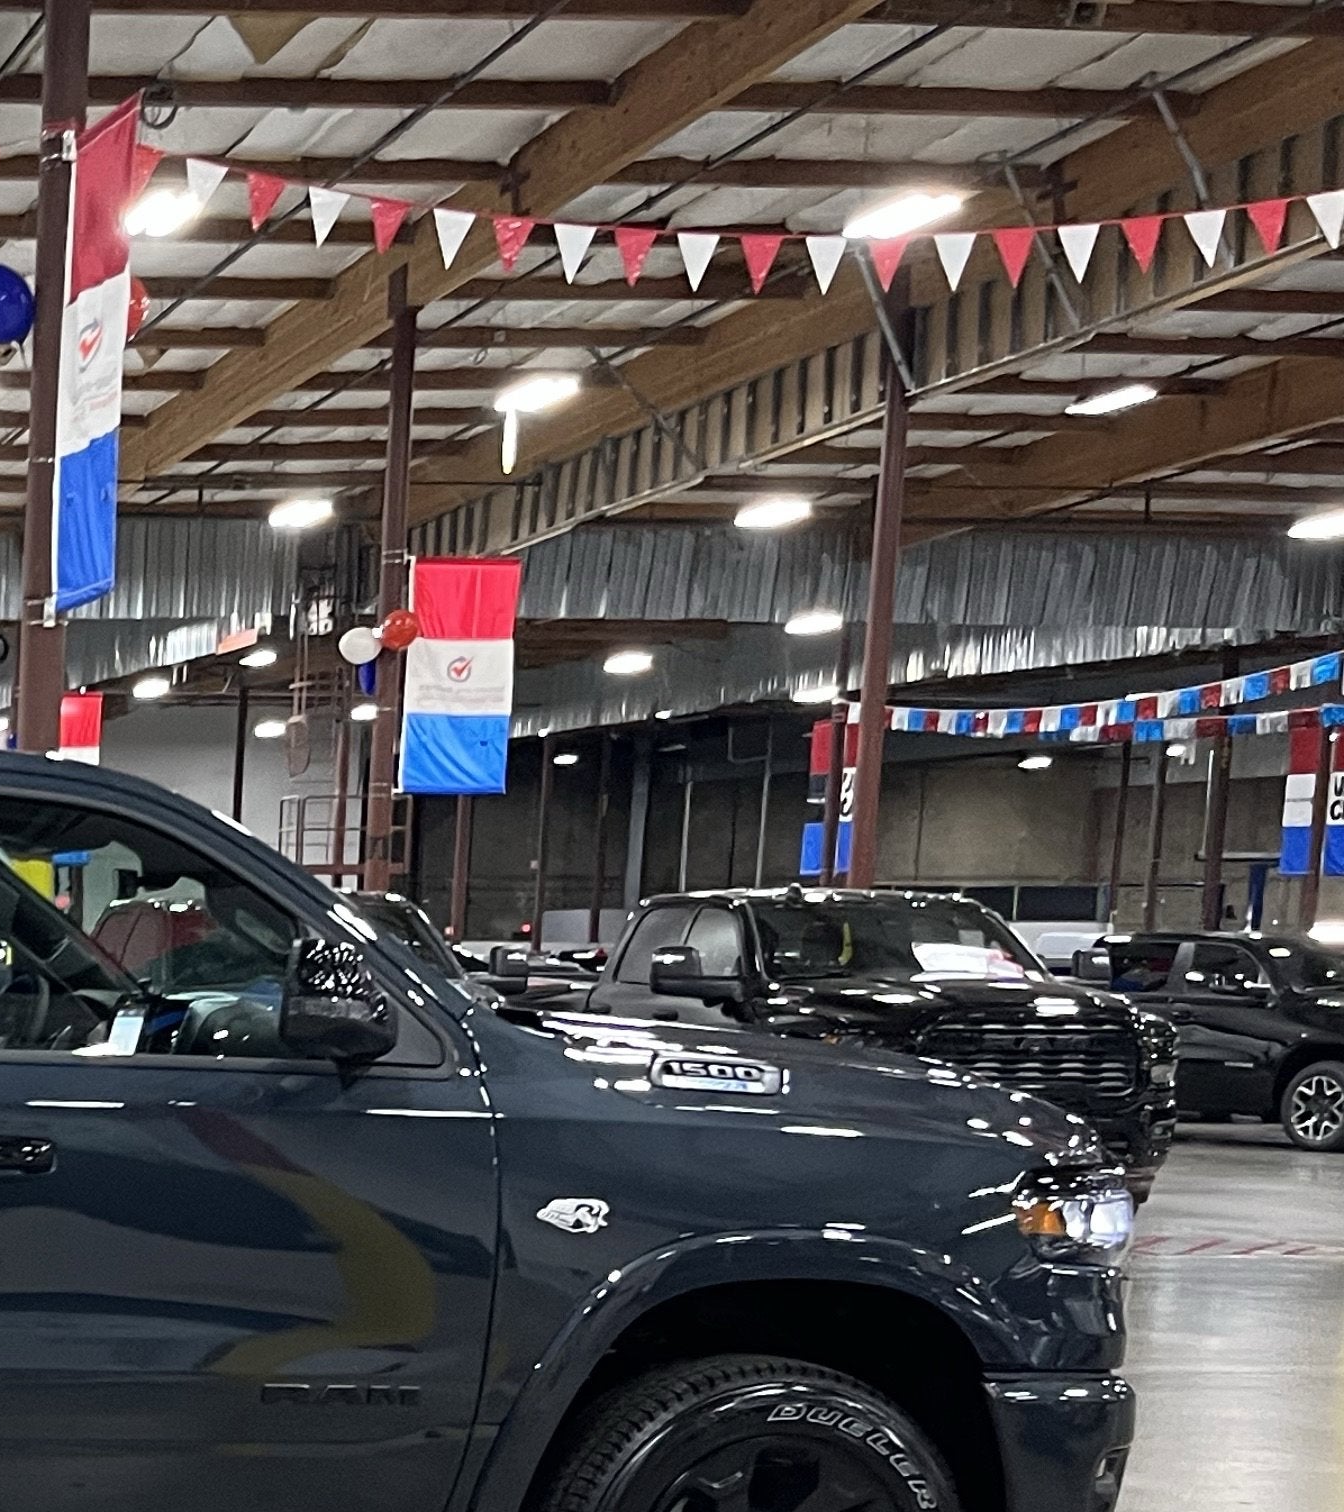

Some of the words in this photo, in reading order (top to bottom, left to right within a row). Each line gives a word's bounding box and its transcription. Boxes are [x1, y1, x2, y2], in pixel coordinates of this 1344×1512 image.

[667, 1061, 761, 1081] 1500
[260, 1383, 421, 1405] RAM
[766, 1402, 938, 1511] DUELER
